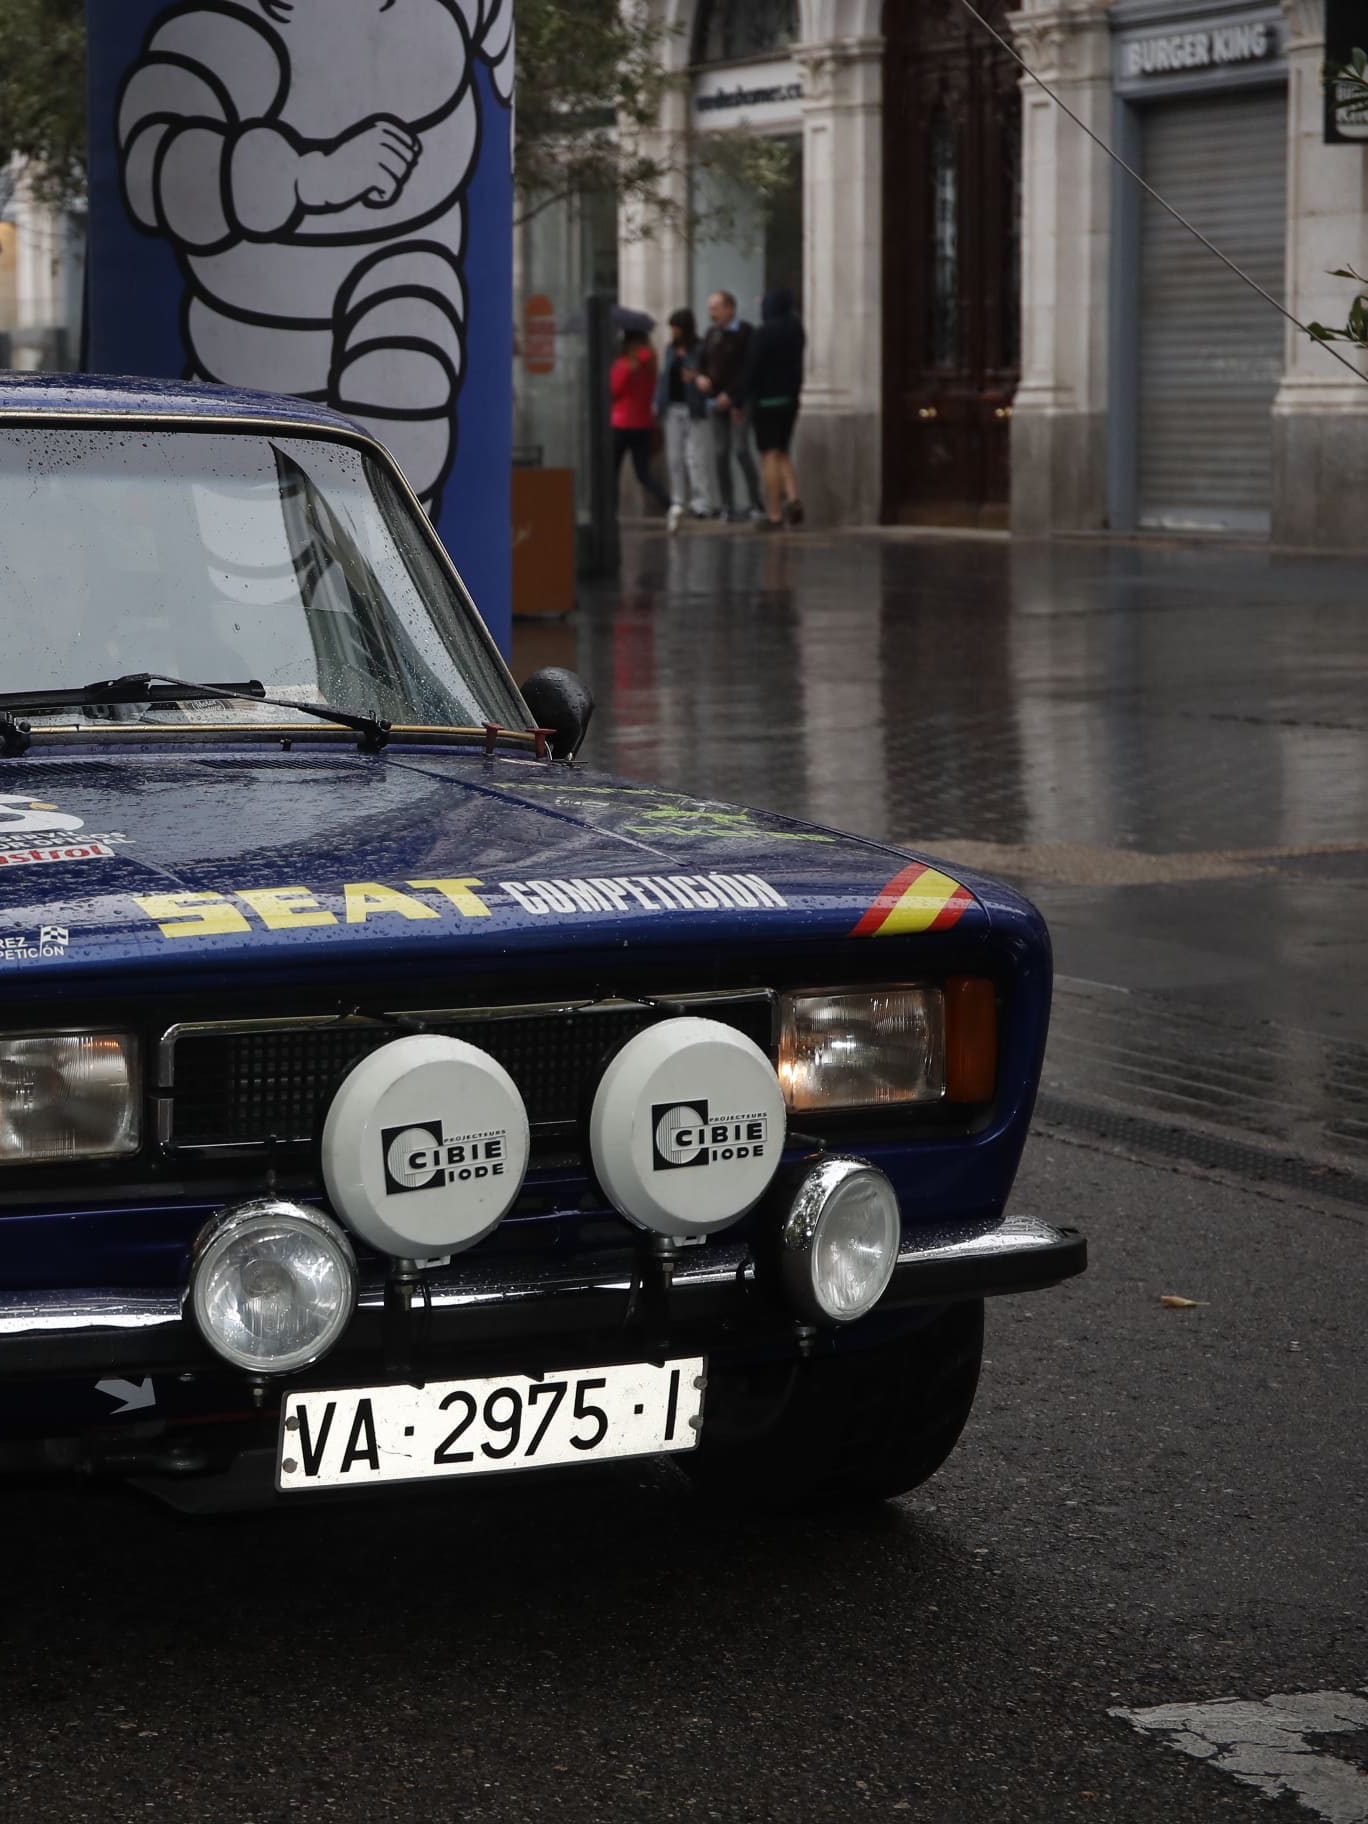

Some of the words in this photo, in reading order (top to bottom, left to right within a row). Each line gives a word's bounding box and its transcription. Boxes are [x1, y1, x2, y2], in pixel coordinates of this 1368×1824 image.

[1127, 33, 1211, 75] BURGER
[1212, 23, 1268, 65] KING
[131, 877, 492, 938] SEAT
[498, 872, 788, 914] COMPETICIÓN
[709, 1112, 768, 1123] PROJECTEURS
[443, 1129, 507, 1143] PROJECTEURS
[675, 1122, 763, 1147] CIBIE
[409, 1140, 502, 1169] CIBIE
[712, 1144, 764, 1161] IODE
[448, 1162, 505, 1183] IODE
